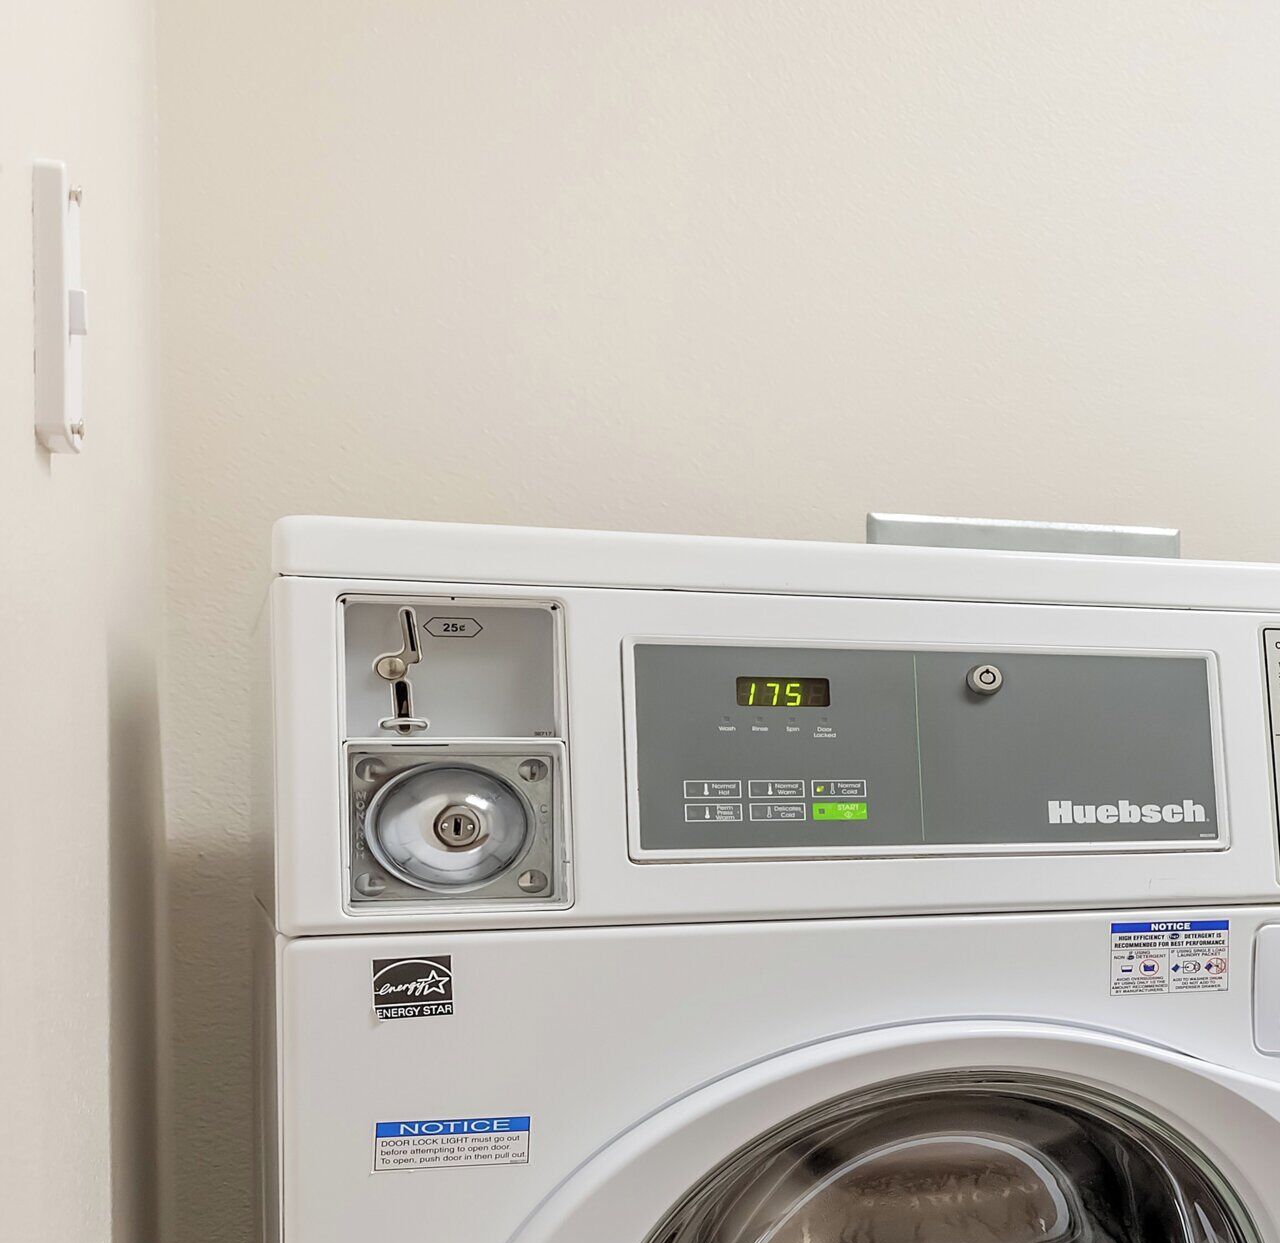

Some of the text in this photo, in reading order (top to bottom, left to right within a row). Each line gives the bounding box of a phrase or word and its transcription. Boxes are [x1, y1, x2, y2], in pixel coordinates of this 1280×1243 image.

[443, 623, 466, 633] 25¢
[748, 683, 801, 706] 175
[1048, 800, 1206, 824] Huebsch
[1151, 922, 1191, 931] NOTICE
[377, 1004, 453, 1019] ENERGY STAR
[400, 1119, 510, 1135] NOTICE
[381, 1139, 410, 1147] DOOR
[412, 1138, 438, 1146] LOCK
[441, 1136, 469, 1144] LIGHT
[381, 1147, 408, 1156] before
[410, 1145, 455, 1155] attempting
[467, 1145, 489, 1153] open
[392, 1157, 417, 1166] open,
[419, 1155, 440, 1164] push
[442, 1153, 463, 1161] door
[474, 1152, 493, 1160] then
[494, 1151, 510, 1160] pull
